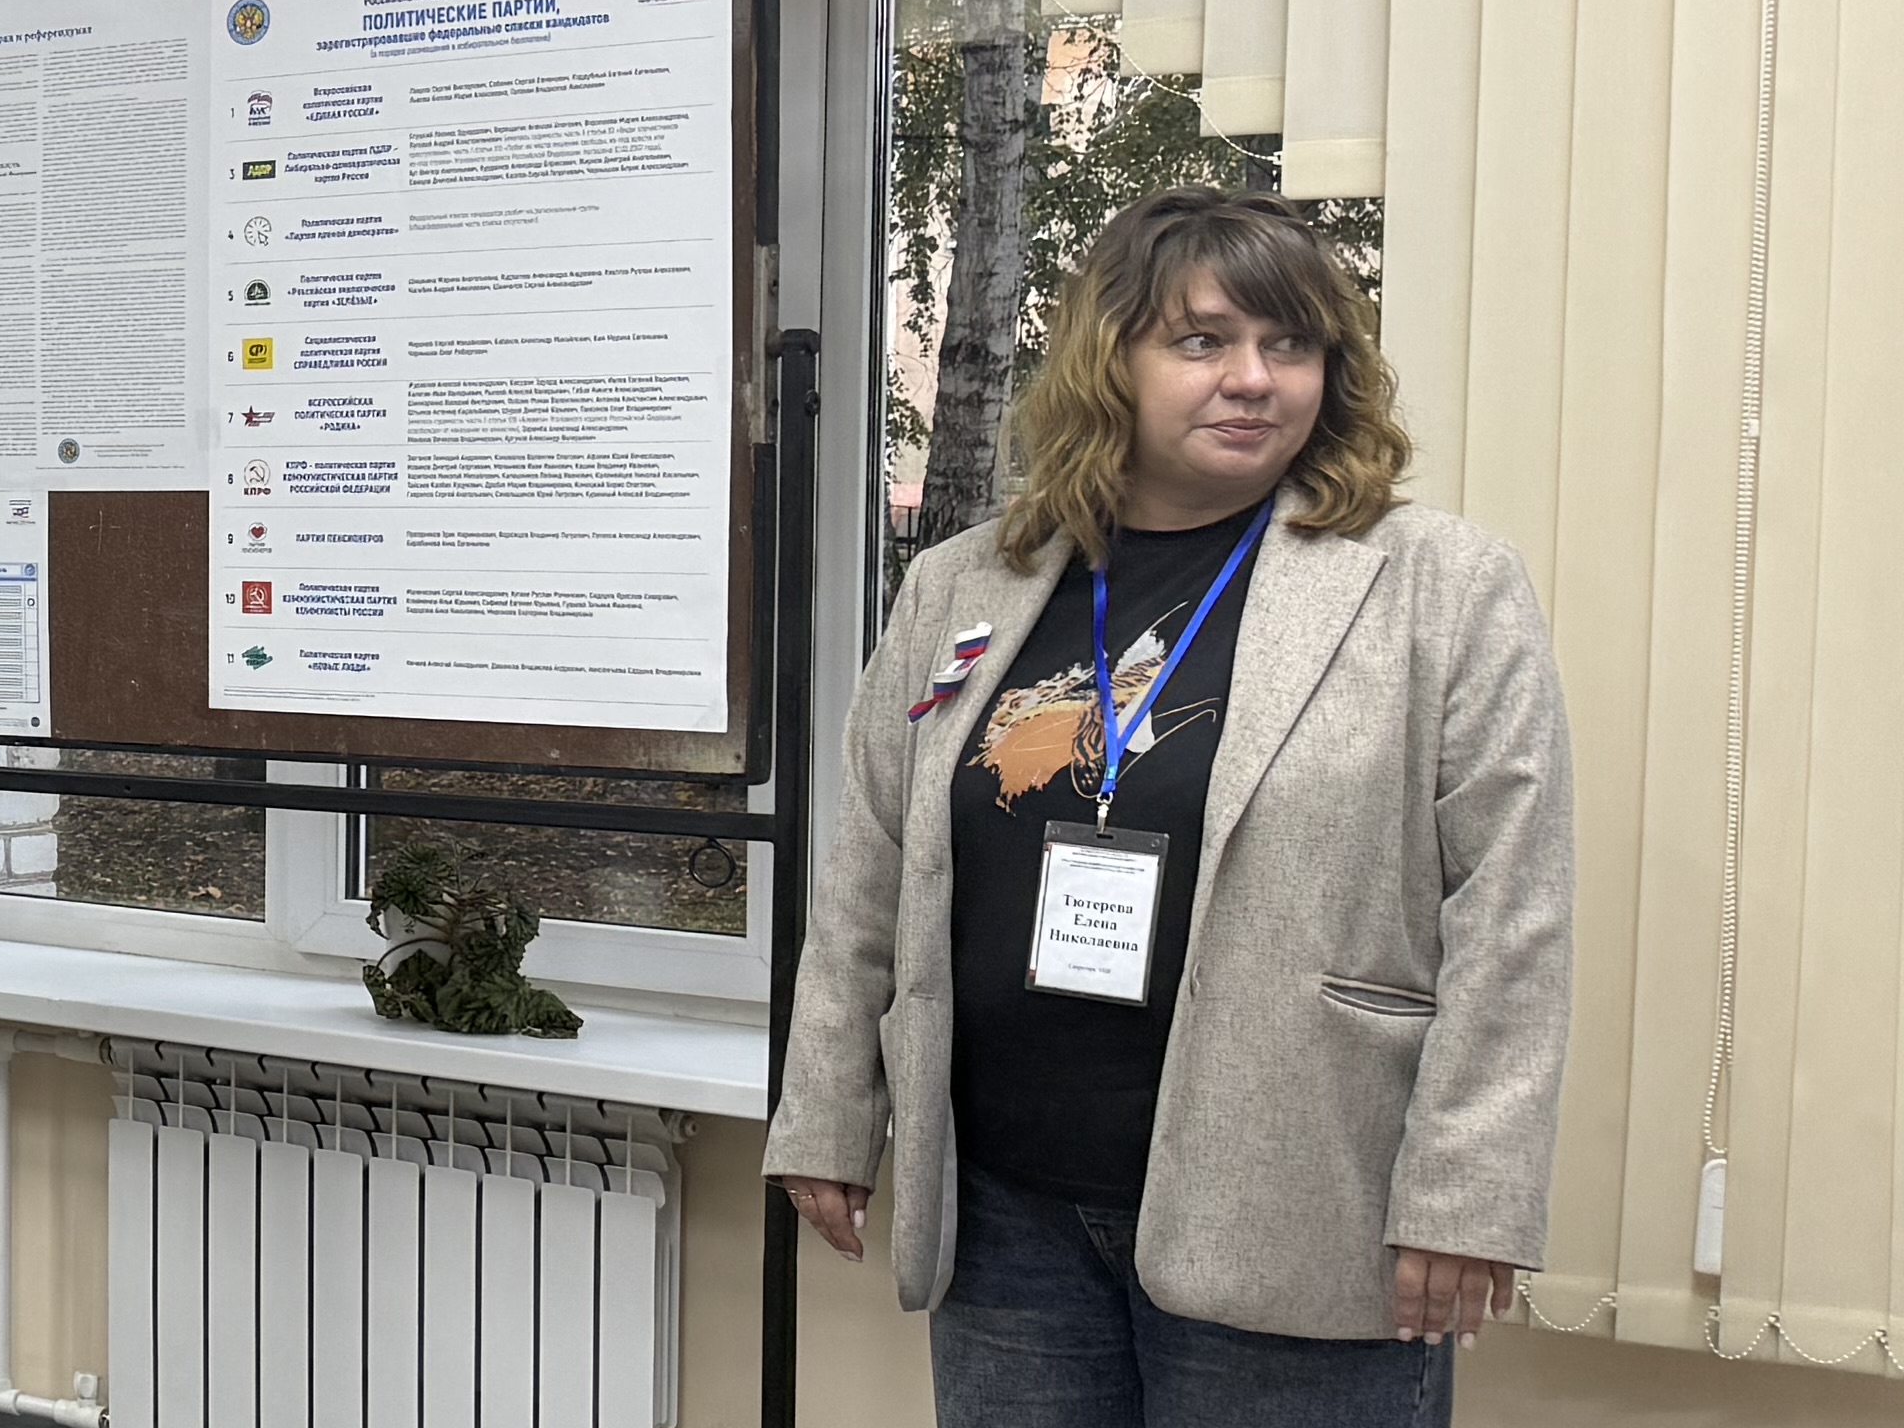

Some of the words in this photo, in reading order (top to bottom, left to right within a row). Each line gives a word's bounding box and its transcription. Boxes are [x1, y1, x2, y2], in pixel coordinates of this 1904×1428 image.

[363, 3, 487, 31] ПОЛИТИЧЕСКИЕ
[228, 290, 233, 301] 5
[228, 412, 234, 423] 7
[244, 487, 271, 495] КПРФ
[1074, 913, 1117, 931] Елена
[1049, 928, 1138, 952] Николаевна
